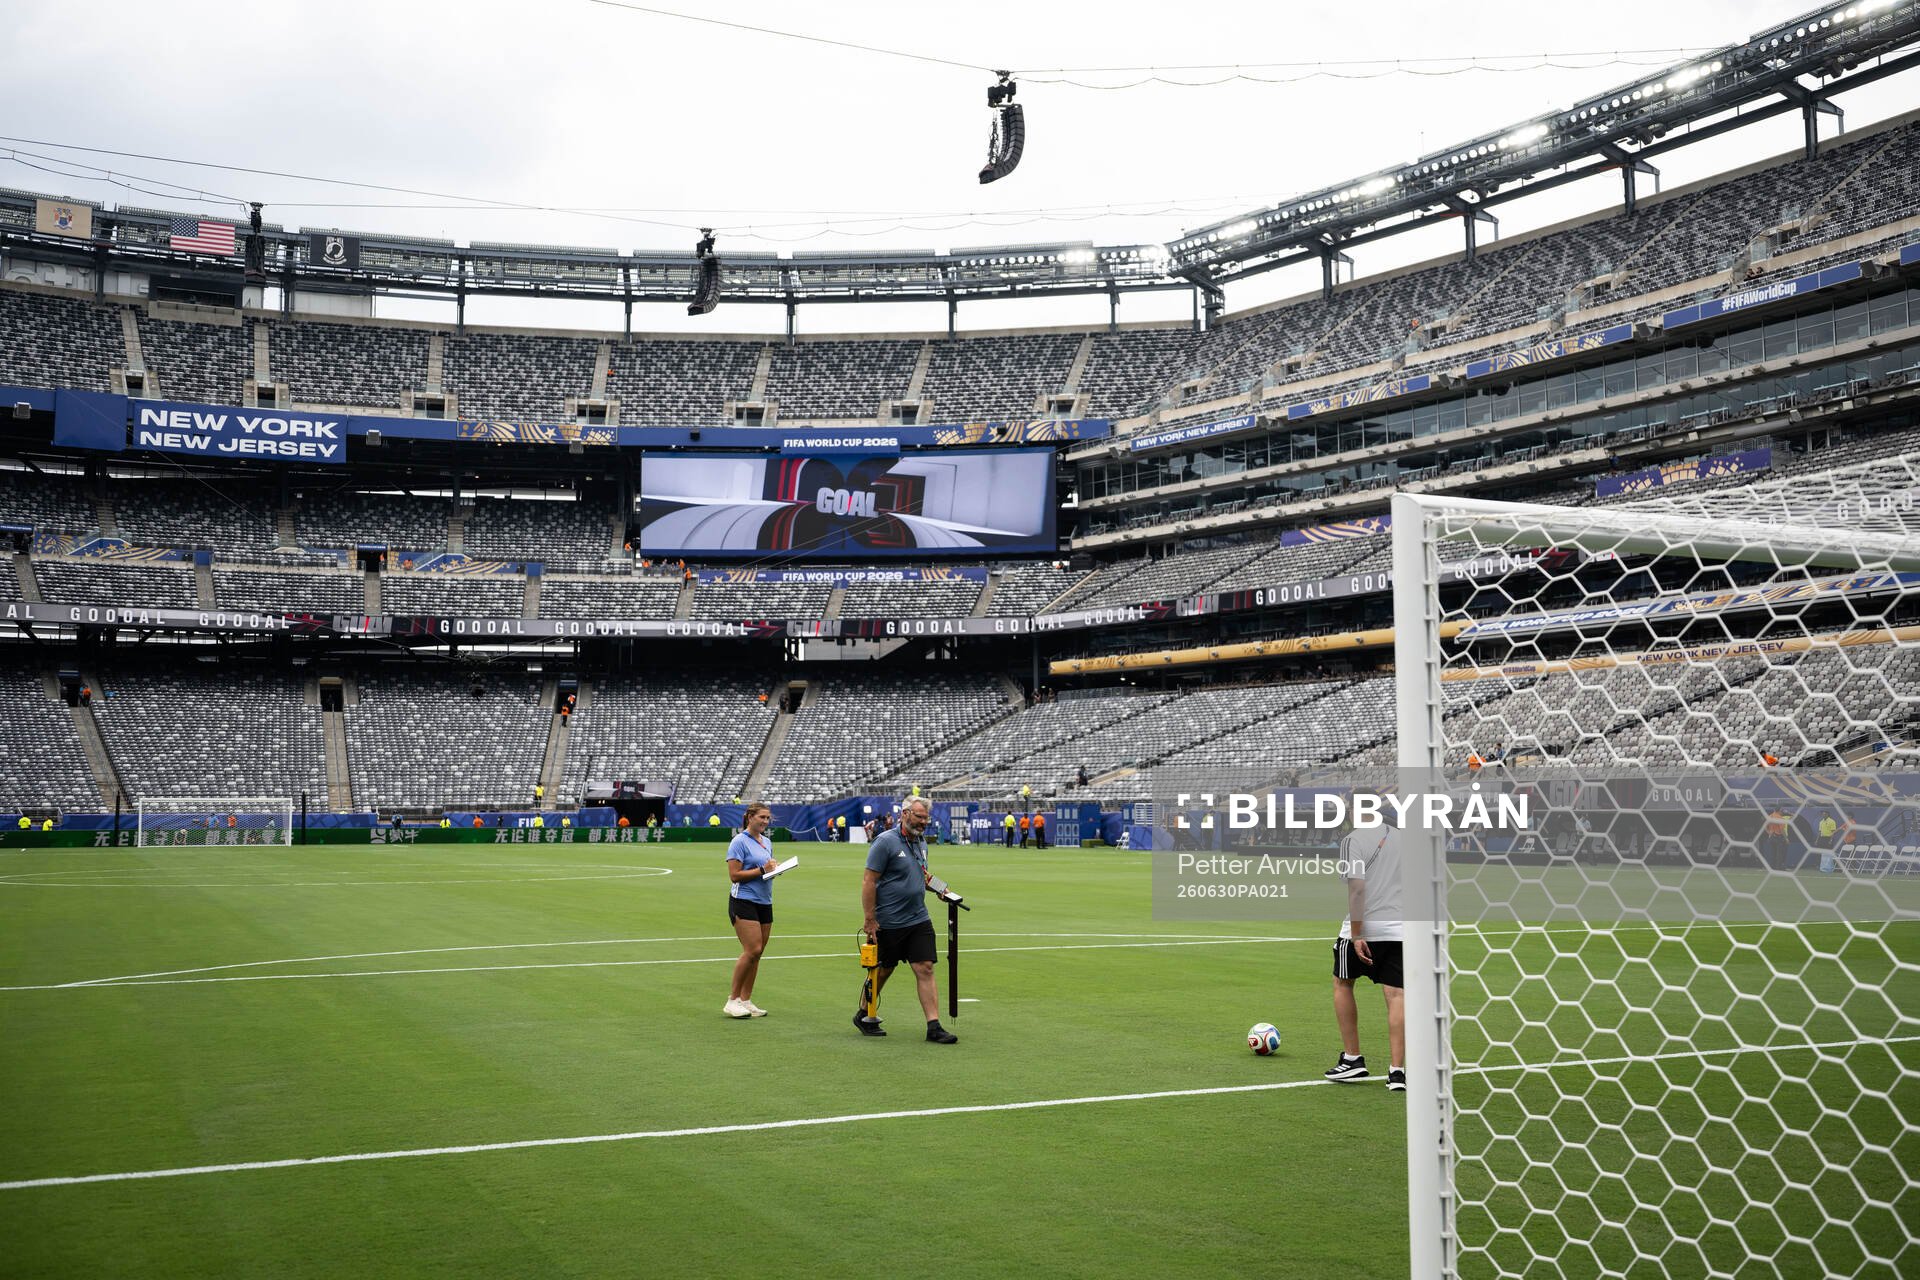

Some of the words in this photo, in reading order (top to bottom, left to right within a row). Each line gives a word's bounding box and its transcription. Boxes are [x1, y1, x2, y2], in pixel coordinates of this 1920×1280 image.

[1722, 282, 1796, 311] #FIFAWorldCup
[140, 409, 228, 431] NEW
[236, 416, 338, 438] YORK
[1136, 437, 1157, 448] NEW
[1159, 432, 1186, 443] YORK
[1186, 426, 1208, 438] NEW
[1210, 418, 1250, 432] JERSEY
[140, 432, 211, 450] NEW
[218, 438, 338, 458] JERSEY
[784, 439, 804, 448] FIFA
[806, 438, 840, 448] WORLD
[842, 438, 862, 447] CUP
[863, 438, 898, 446] 2026
[816, 487, 878, 518] GOAL
[783, 572, 805, 580] FIFA
[806, 572, 843, 580] WORLD
[844, 572, 866, 580] CUP
[867, 572, 903, 580] 2026
[1256, 582, 1326, 605] GOOOAL
[6, 605, 34, 618] AL
[70, 607, 165, 624] GOOOAL
[200, 612, 290, 629] GOOOAL
[440, 620, 524, 634] GOOOAL
[555, 622, 637, 636] GOOOAL
[667, 622, 748, 636] GOOOAL
[886, 620, 966, 634] GOOOAL
[1084, 605, 1146, 625] GOOOAL
[1667, 650, 1698, 660] YORK
[1734, 642, 1784, 654] JERSEY
[1652, 788, 1713, 802] GOOOAL
[494, 828, 574, 843] 无论谁夺冠
[588, 828, 665, 842] 都来找蒙牛
